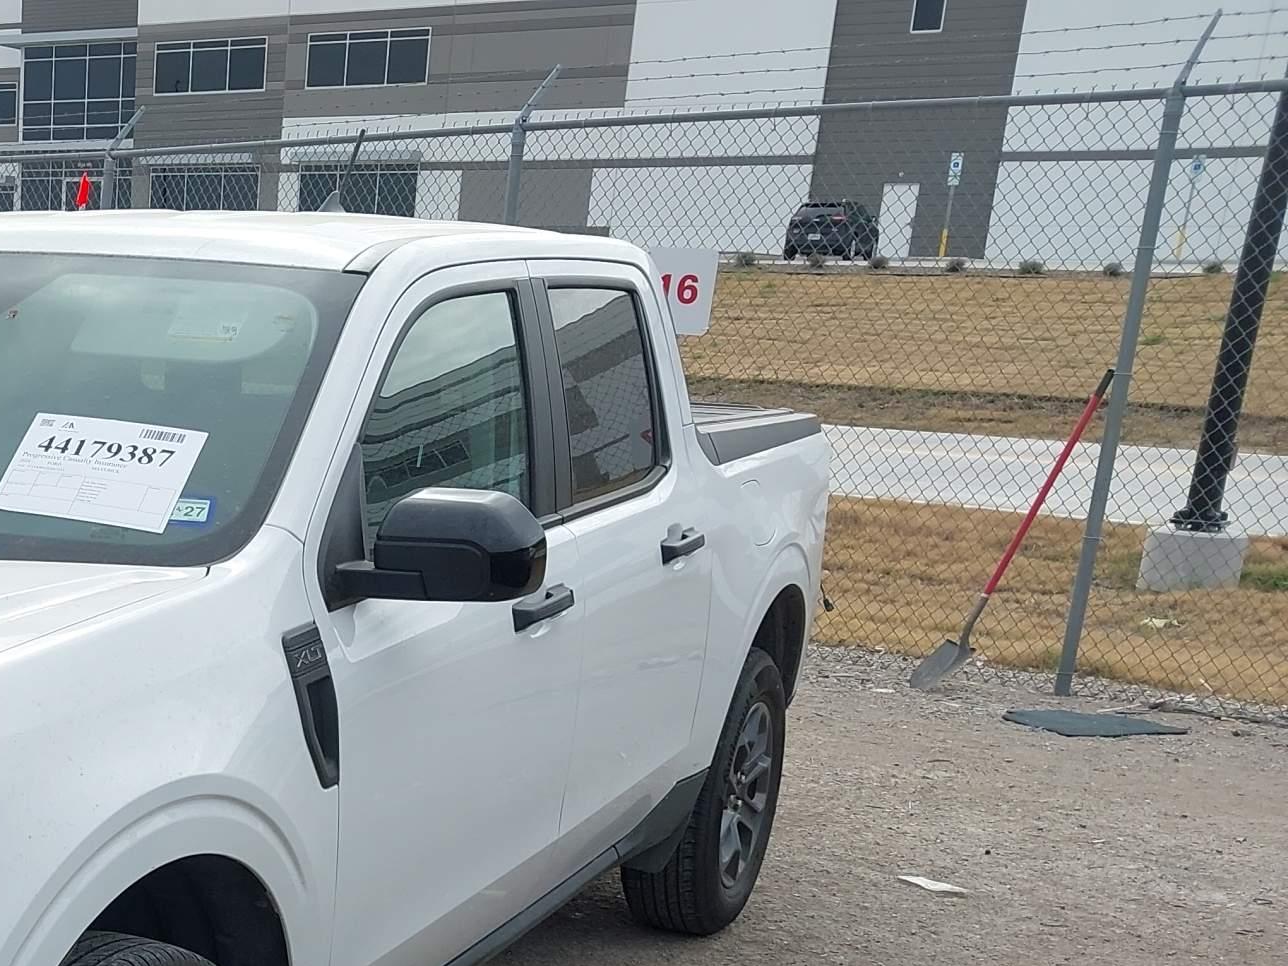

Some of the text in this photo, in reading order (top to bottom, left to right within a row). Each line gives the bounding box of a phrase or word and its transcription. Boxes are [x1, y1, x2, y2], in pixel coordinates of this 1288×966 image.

[661, 273, 699, 305] 16
[37, 435, 177, 467] 44179387
[183, 505, 206, 518] 27
